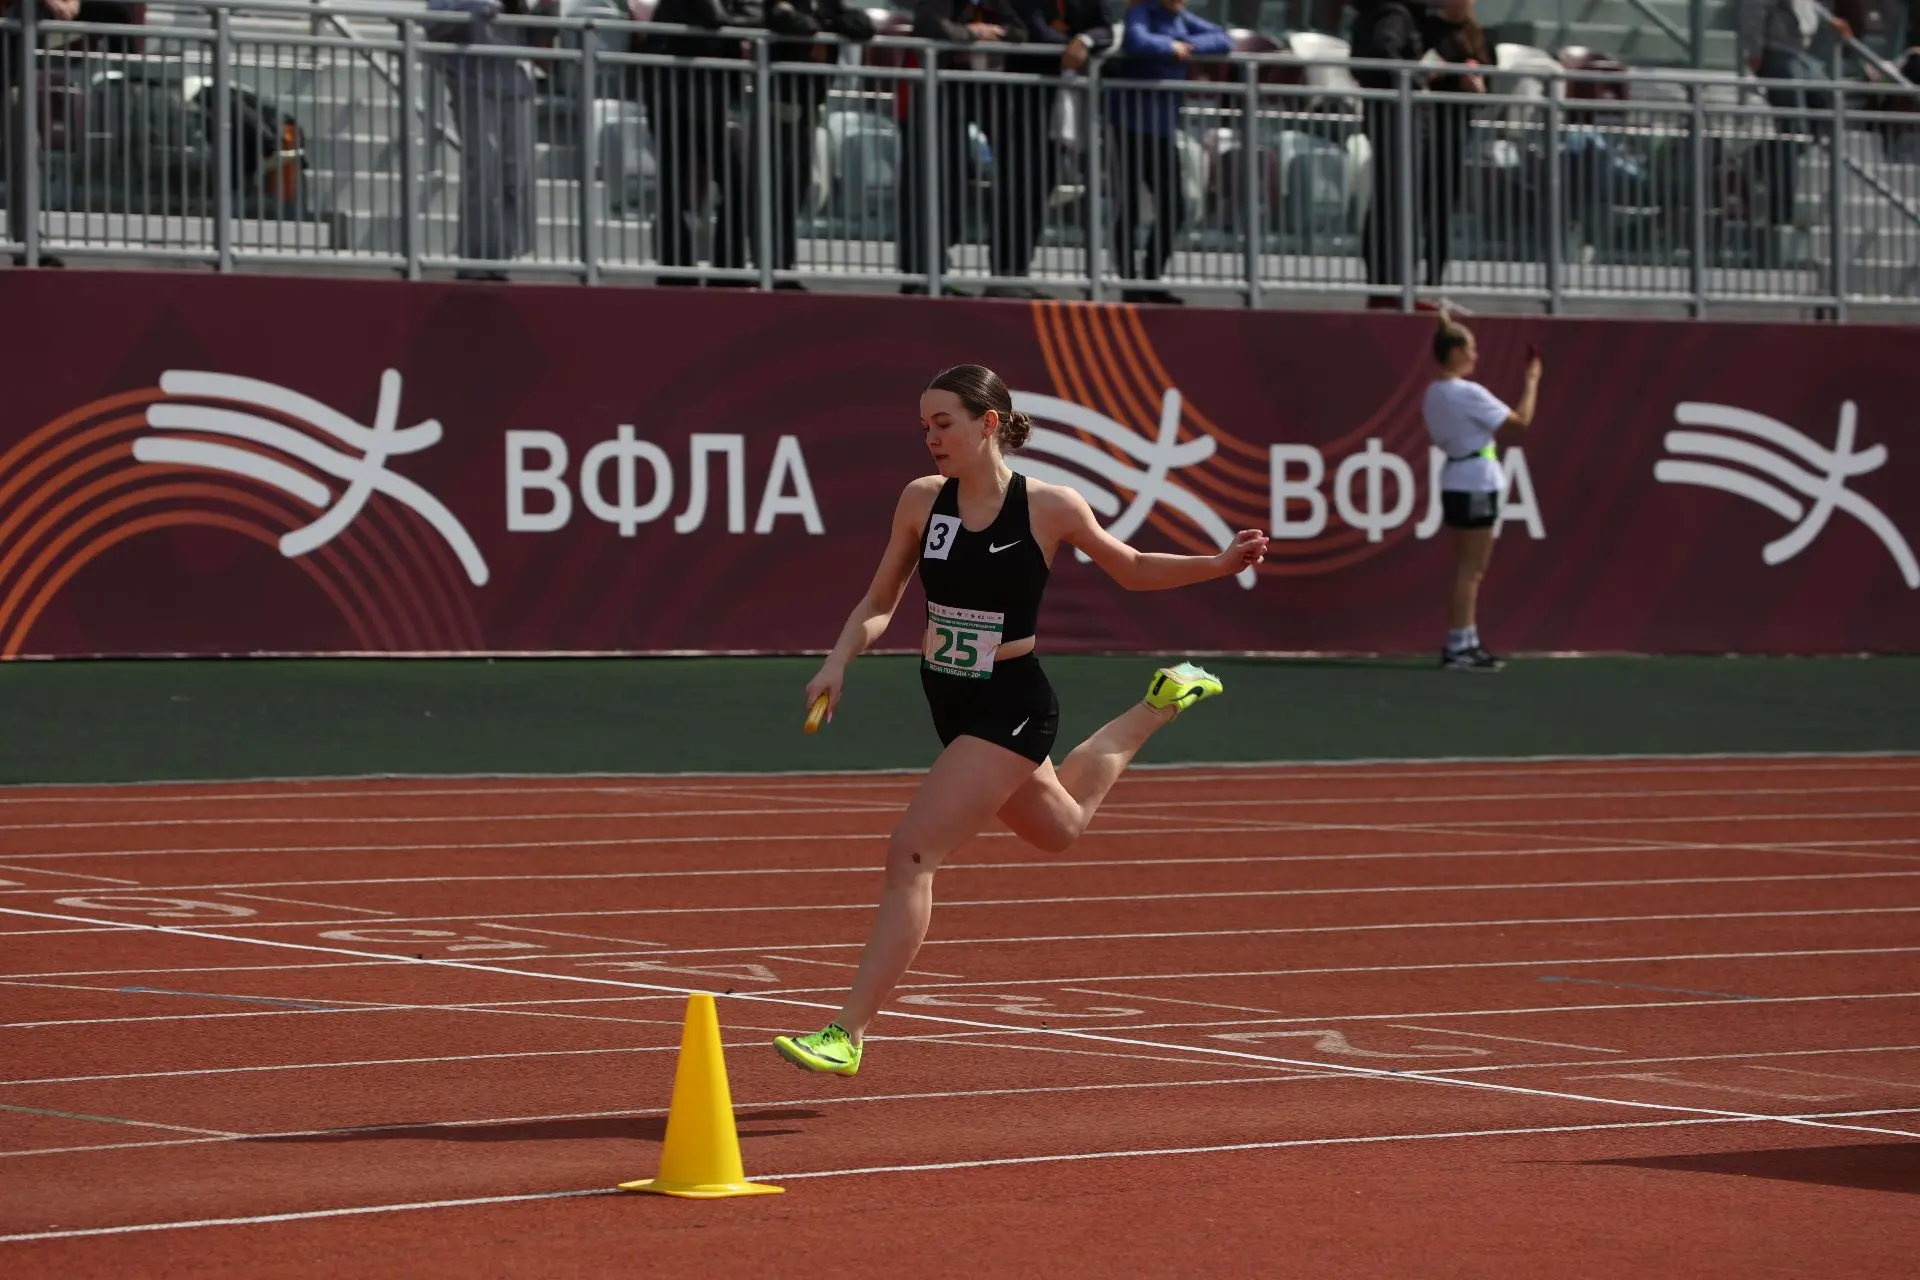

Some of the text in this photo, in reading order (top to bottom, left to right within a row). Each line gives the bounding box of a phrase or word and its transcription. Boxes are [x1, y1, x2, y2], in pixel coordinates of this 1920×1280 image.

[505, 424, 826, 538] ВФЛА
[929, 522, 950, 551] 3
[933, 627, 979, 668] 25
[943, 667, 967, 677] ПОБЕДЫ
